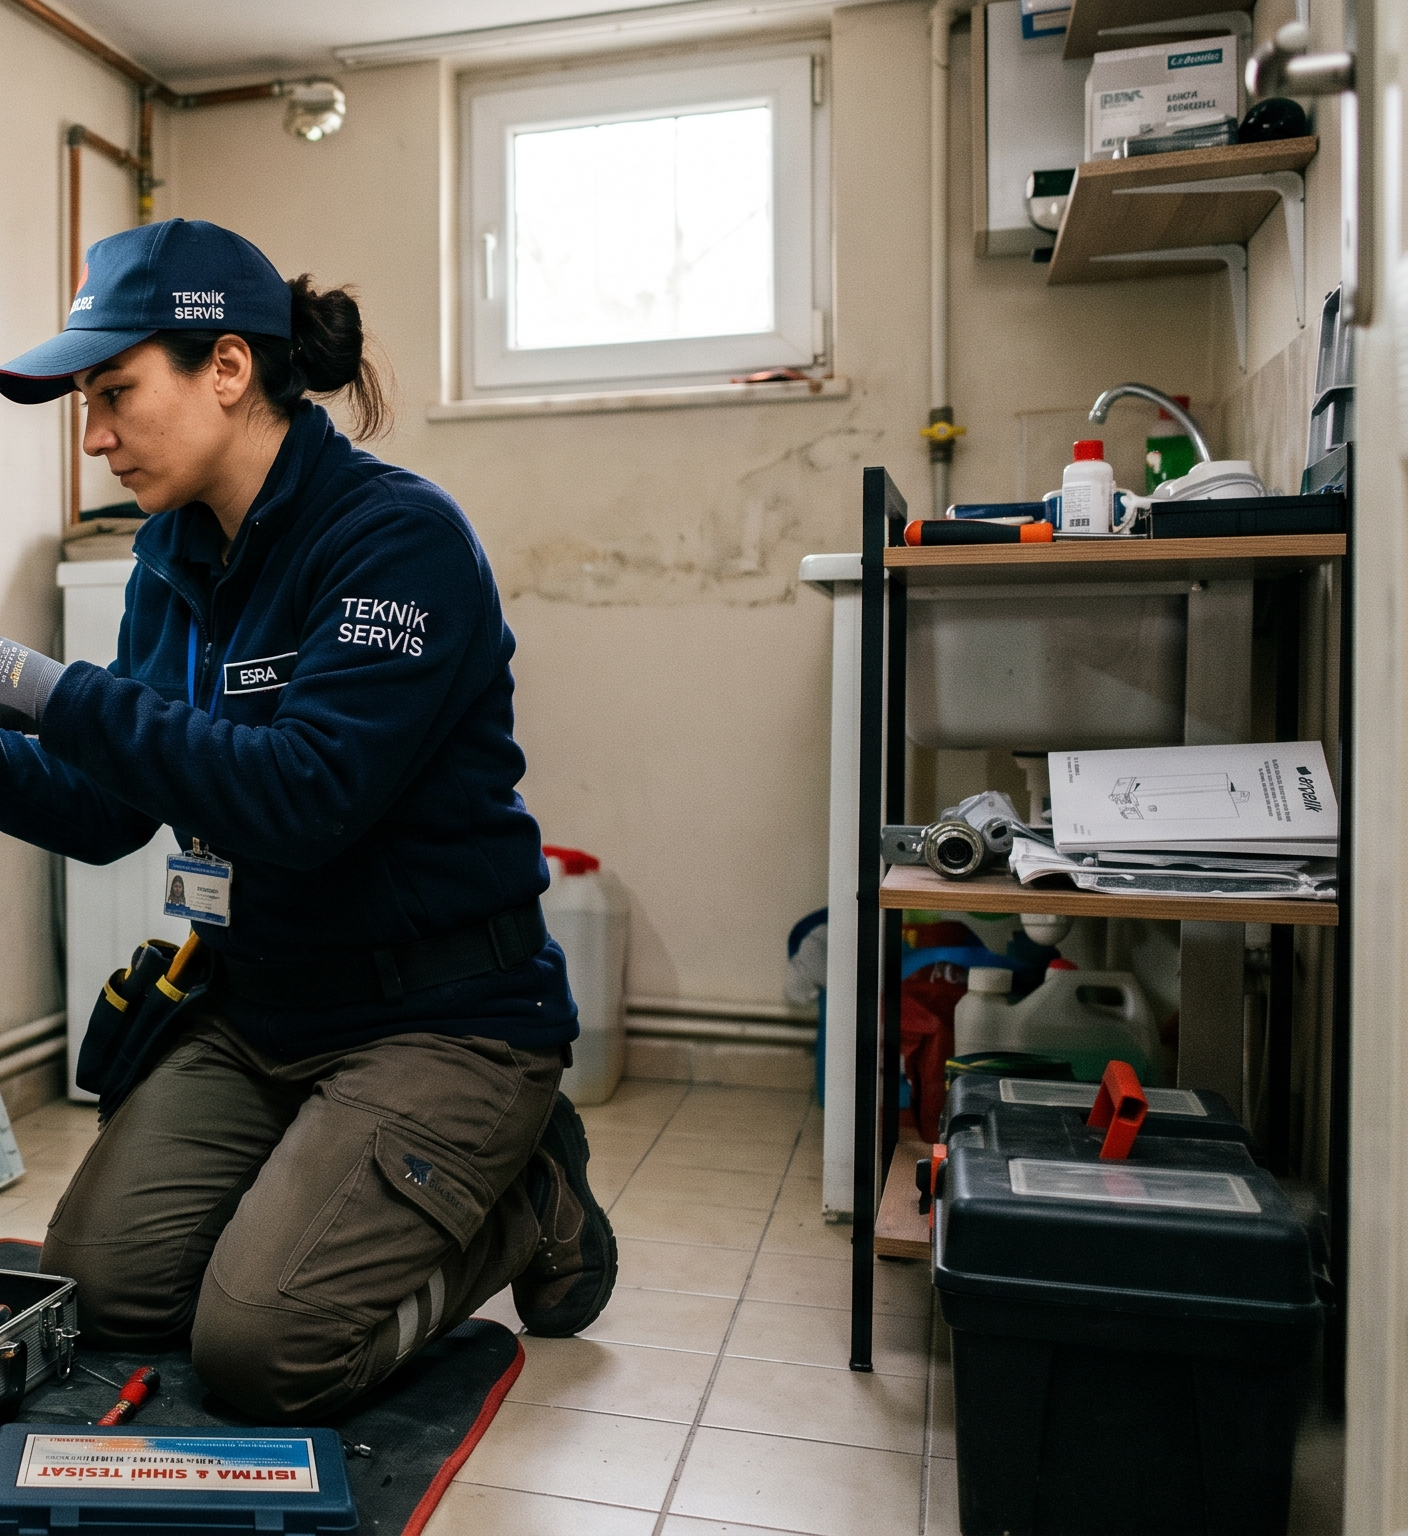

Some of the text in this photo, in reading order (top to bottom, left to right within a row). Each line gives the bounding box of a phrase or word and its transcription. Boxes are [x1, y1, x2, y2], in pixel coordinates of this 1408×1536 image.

[172, 289, 225, 304] TEKNİK
[174, 305, 224, 320] SERVİS
[341, 597, 429, 633] TEKNİK
[337, 622, 424, 657] SERVİS
[240, 666, 278, 685] ESRA
[37, 1466, 297, 1481] ISITMA & SIHHİ TESİSAT
